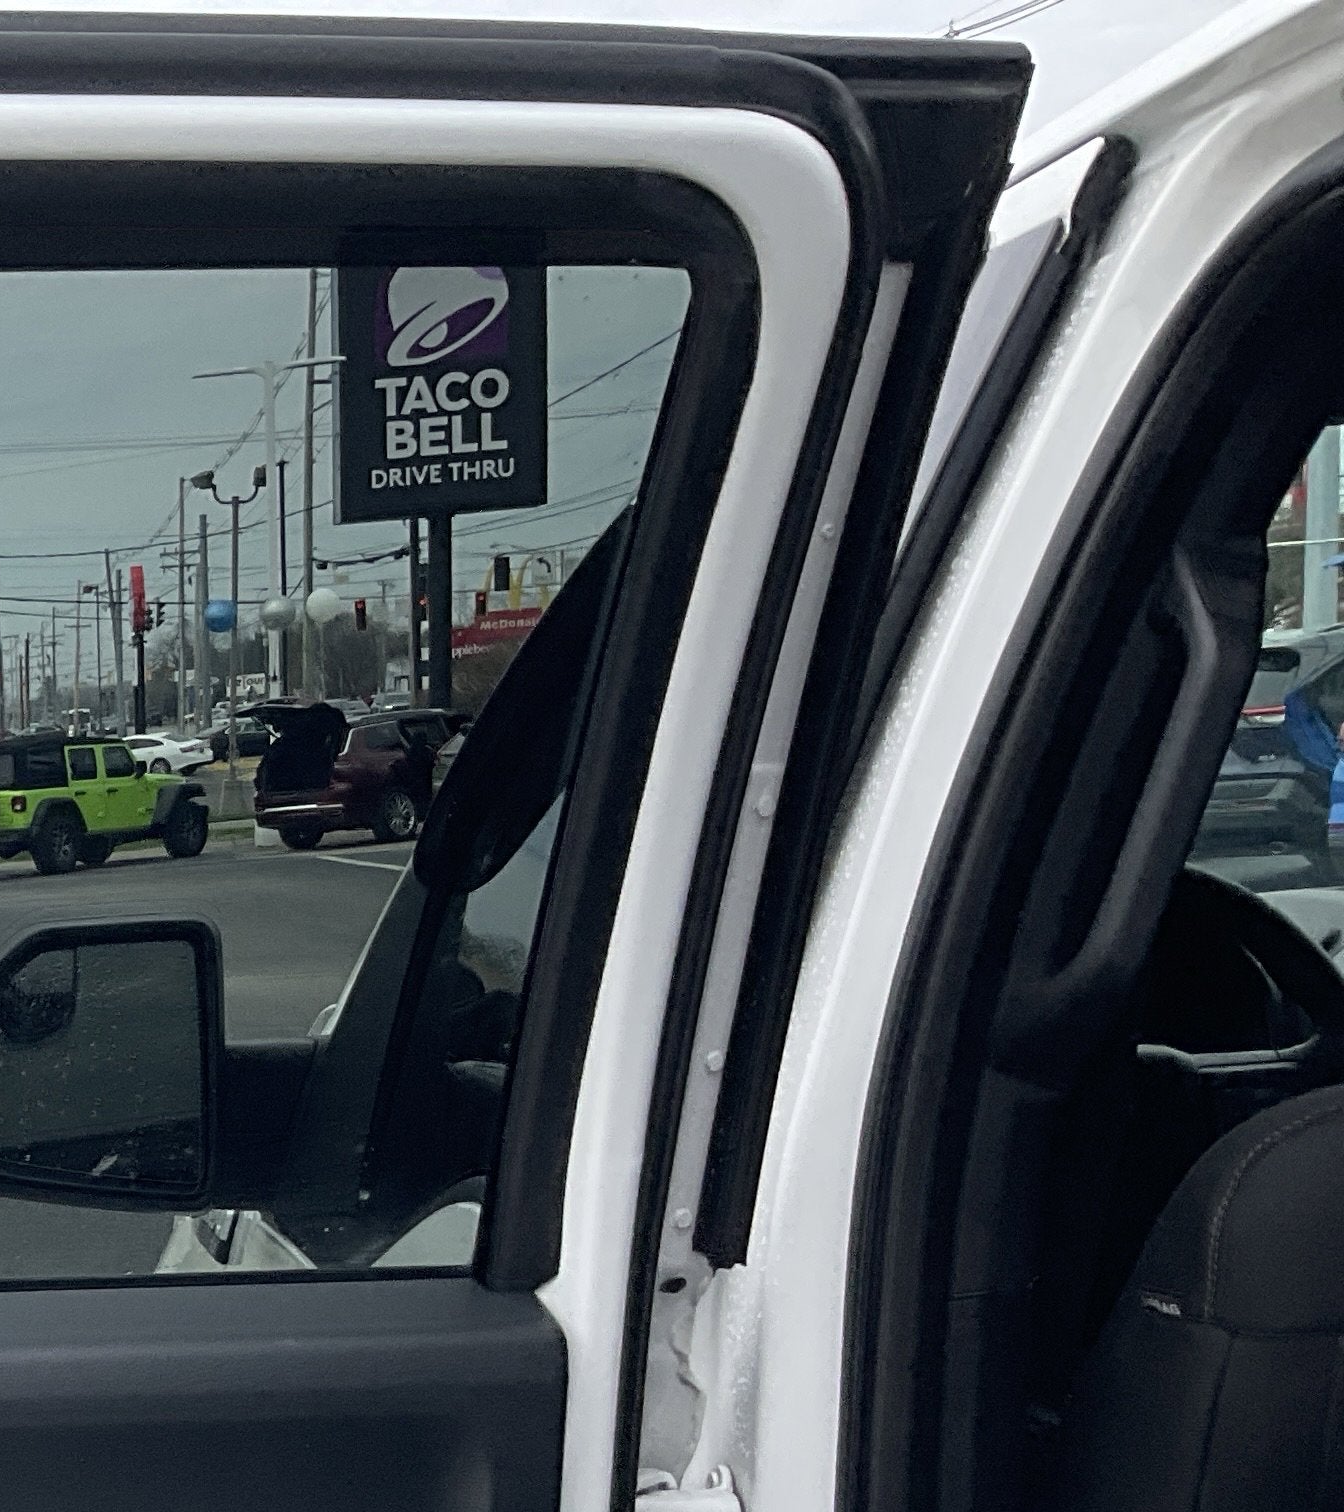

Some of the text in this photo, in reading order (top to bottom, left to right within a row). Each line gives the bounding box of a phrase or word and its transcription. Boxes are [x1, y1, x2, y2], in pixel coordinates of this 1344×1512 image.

[374, 368, 510, 417] TACO
[386, 412, 509, 460] BELL
[370, 457, 515, 489] DRIVE THRU
